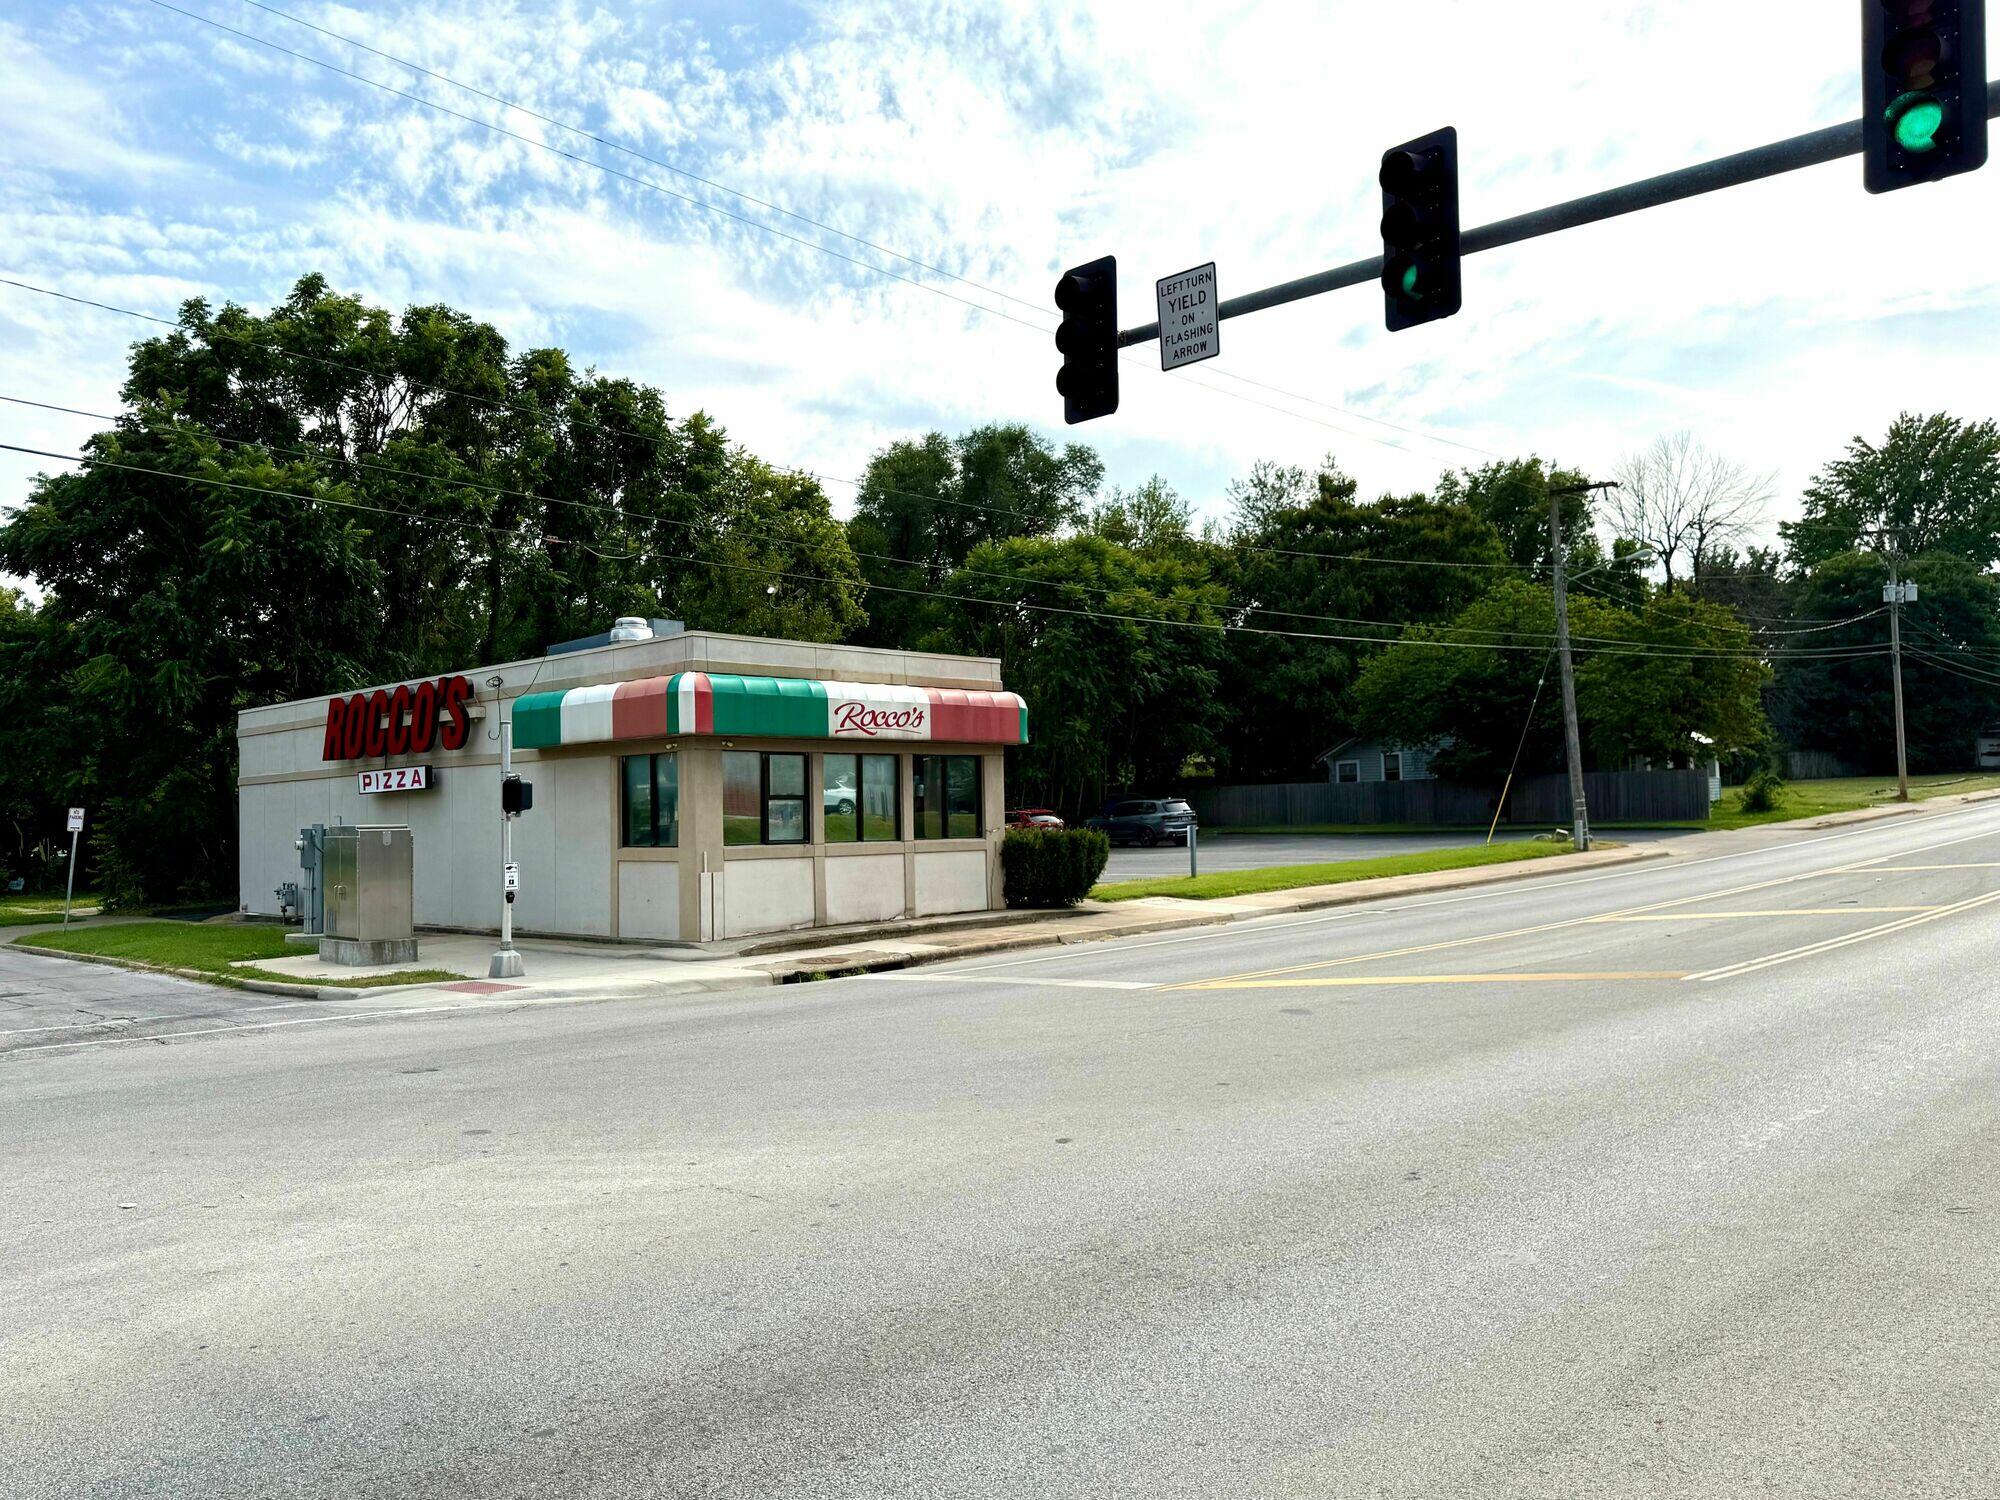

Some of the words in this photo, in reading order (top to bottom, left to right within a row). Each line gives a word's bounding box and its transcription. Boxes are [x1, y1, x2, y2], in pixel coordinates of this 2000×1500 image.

[1160, 280, 1183, 298] LEFT
[1185, 271, 1212, 290] TURN
[1168, 290, 1207, 313] YIELD
[1181, 312, 1195, 326] ON
[1165, 323, 1213, 347] FLASHING
[1173, 341, 1207, 360] ARROW
[323, 675, 470, 761] ROCCO'S
[834, 702, 925, 736] Rocco's
[362, 769, 422, 791] PIZZA
